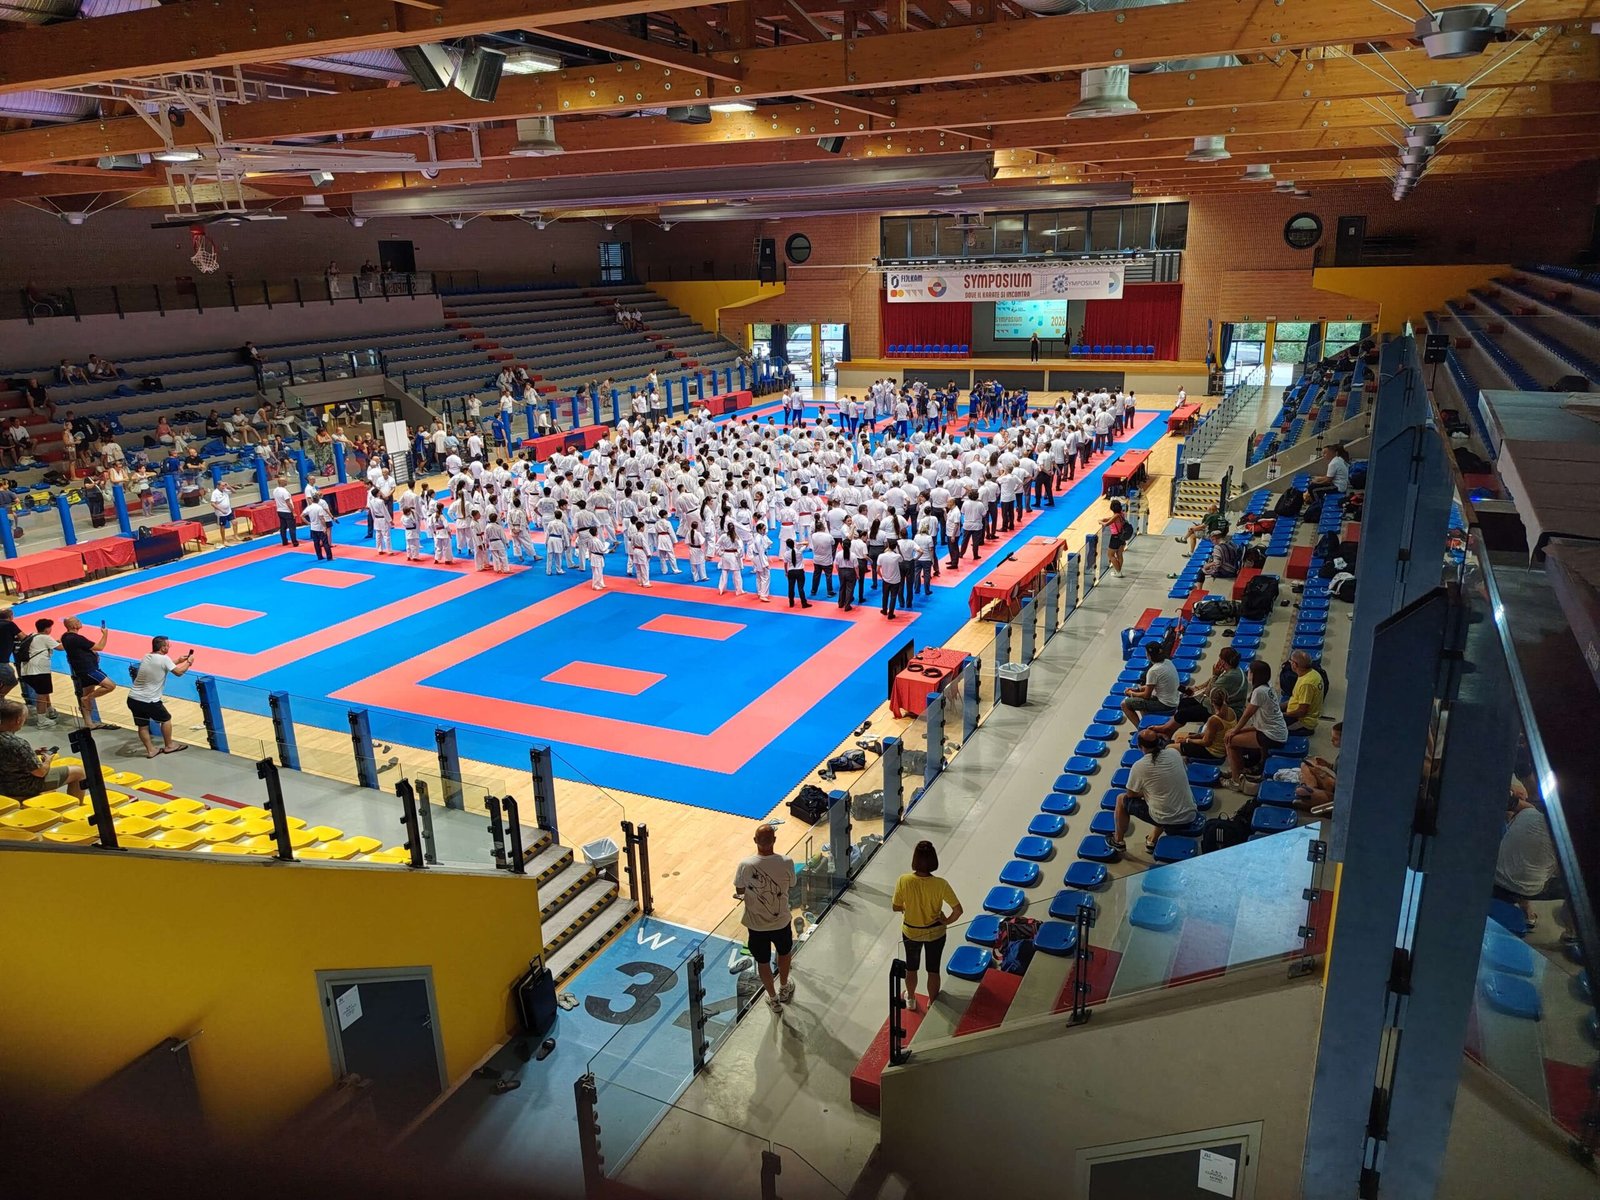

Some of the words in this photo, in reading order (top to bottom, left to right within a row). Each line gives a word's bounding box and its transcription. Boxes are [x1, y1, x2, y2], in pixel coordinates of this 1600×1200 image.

[964, 272, 1032, 289] SYMPOSIUM
[1051, 316, 1066, 327] 2026
[584, 961, 679, 1025] 3
